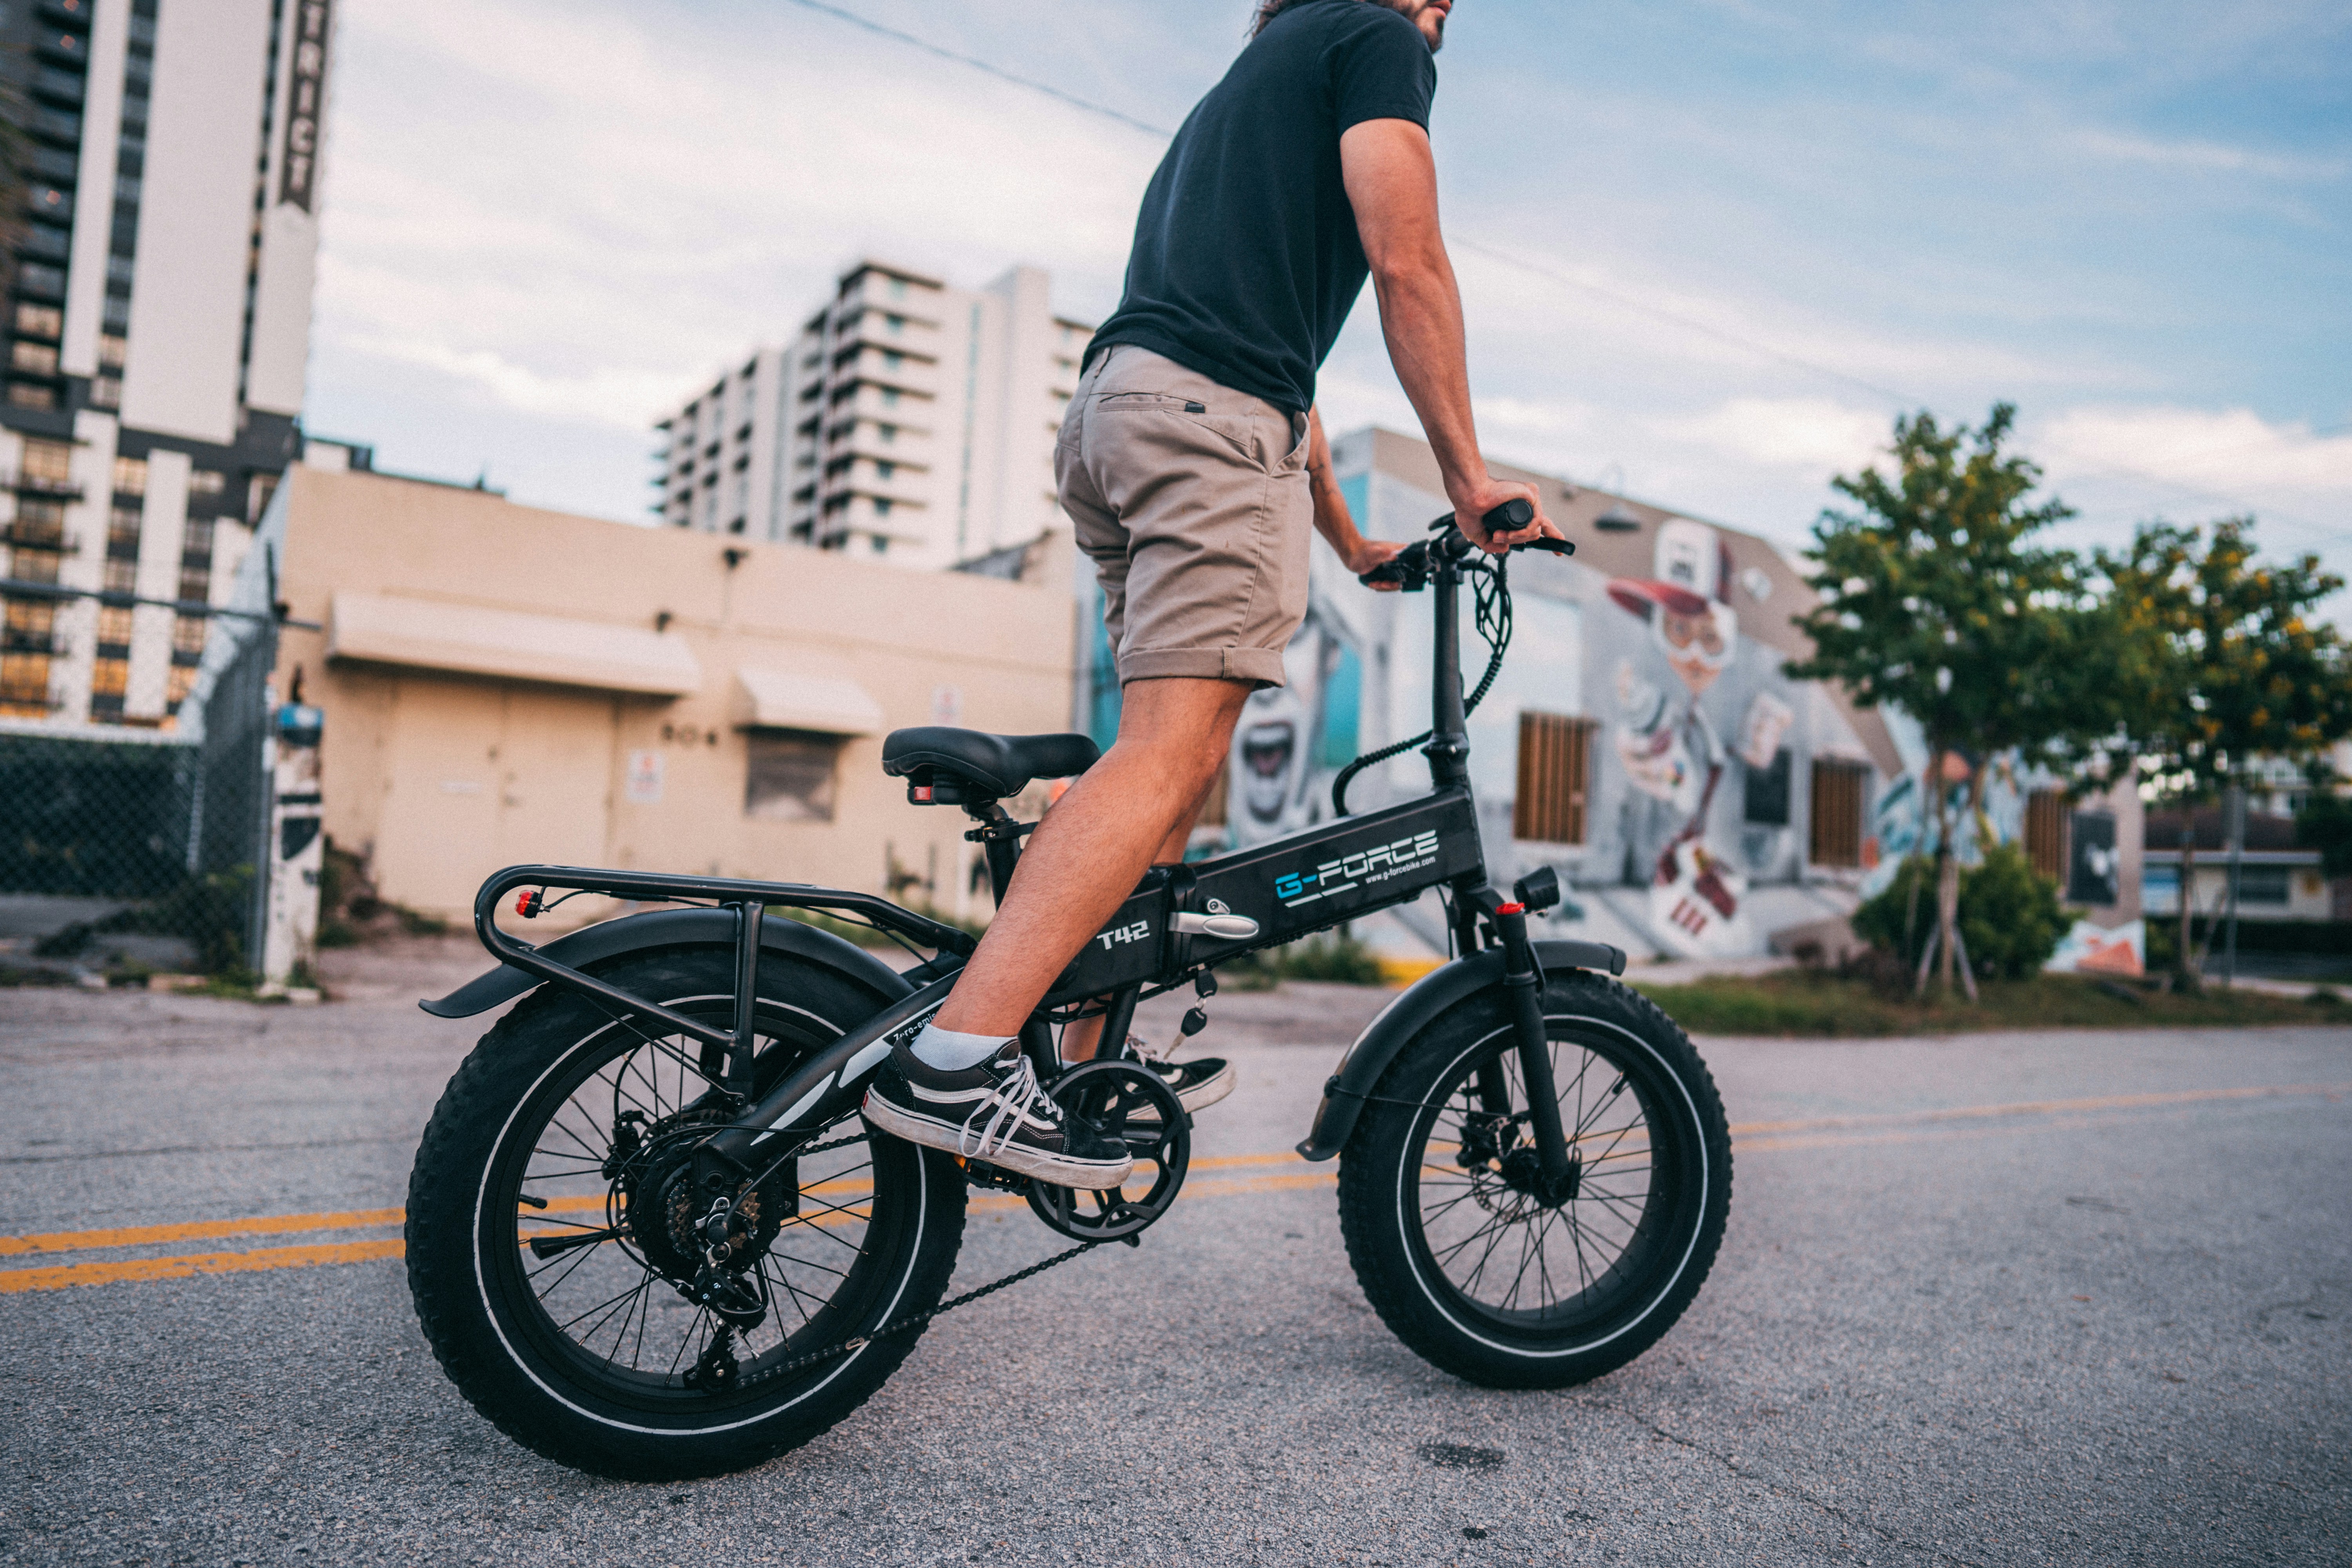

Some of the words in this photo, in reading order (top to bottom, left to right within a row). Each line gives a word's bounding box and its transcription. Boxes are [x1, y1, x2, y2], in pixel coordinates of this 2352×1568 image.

[289, 0, 325, 192] TRICT
[1275, 829, 1439, 898] G-FORCE
[1365, 856, 1436, 884] www.g-forcebike.com
[1096, 920, 1150, 950] T42
